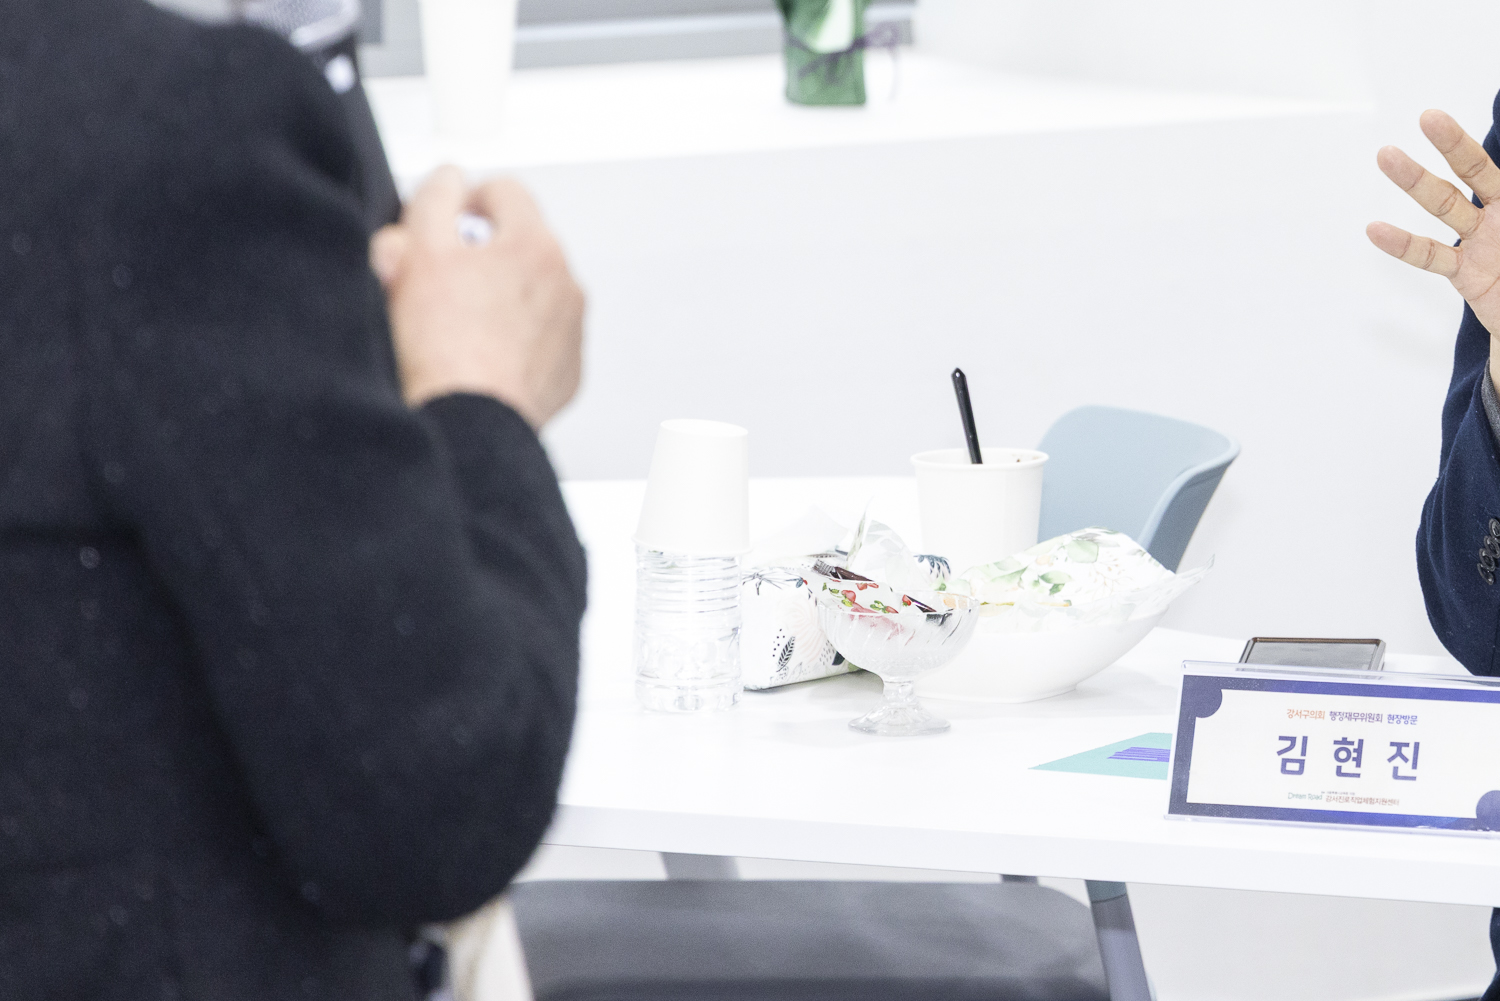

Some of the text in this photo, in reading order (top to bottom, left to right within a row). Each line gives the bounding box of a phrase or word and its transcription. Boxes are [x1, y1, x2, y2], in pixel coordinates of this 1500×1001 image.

[1286, 708, 1418, 726] 강서구의회 행정재무위원회 현장방문
